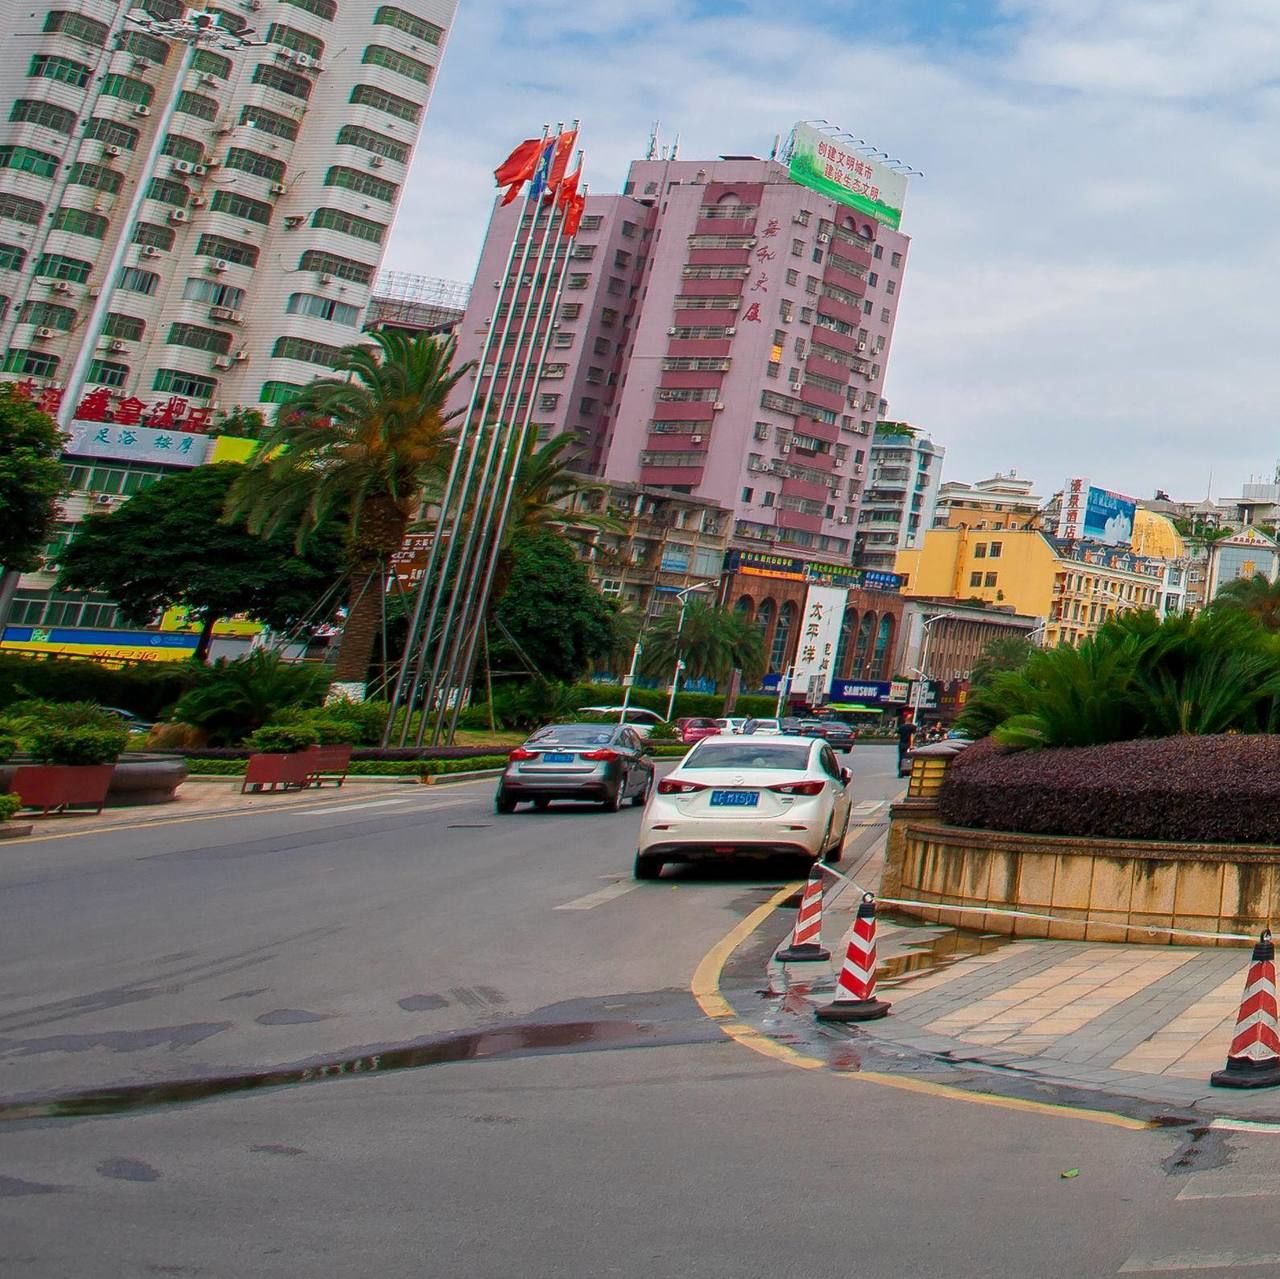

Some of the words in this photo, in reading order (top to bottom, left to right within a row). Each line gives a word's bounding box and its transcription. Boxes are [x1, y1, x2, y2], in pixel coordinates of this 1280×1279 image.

[817, 141, 873, 180] 创建文明城市
[824, 163, 880, 201] 建设生态文明
[92, 427, 138, 445] 足浴
[154, 434, 195, 454] 按摩
[802, 601, 824, 665] 太平洋
[843, 685, 878, 697] SAMSUNG
